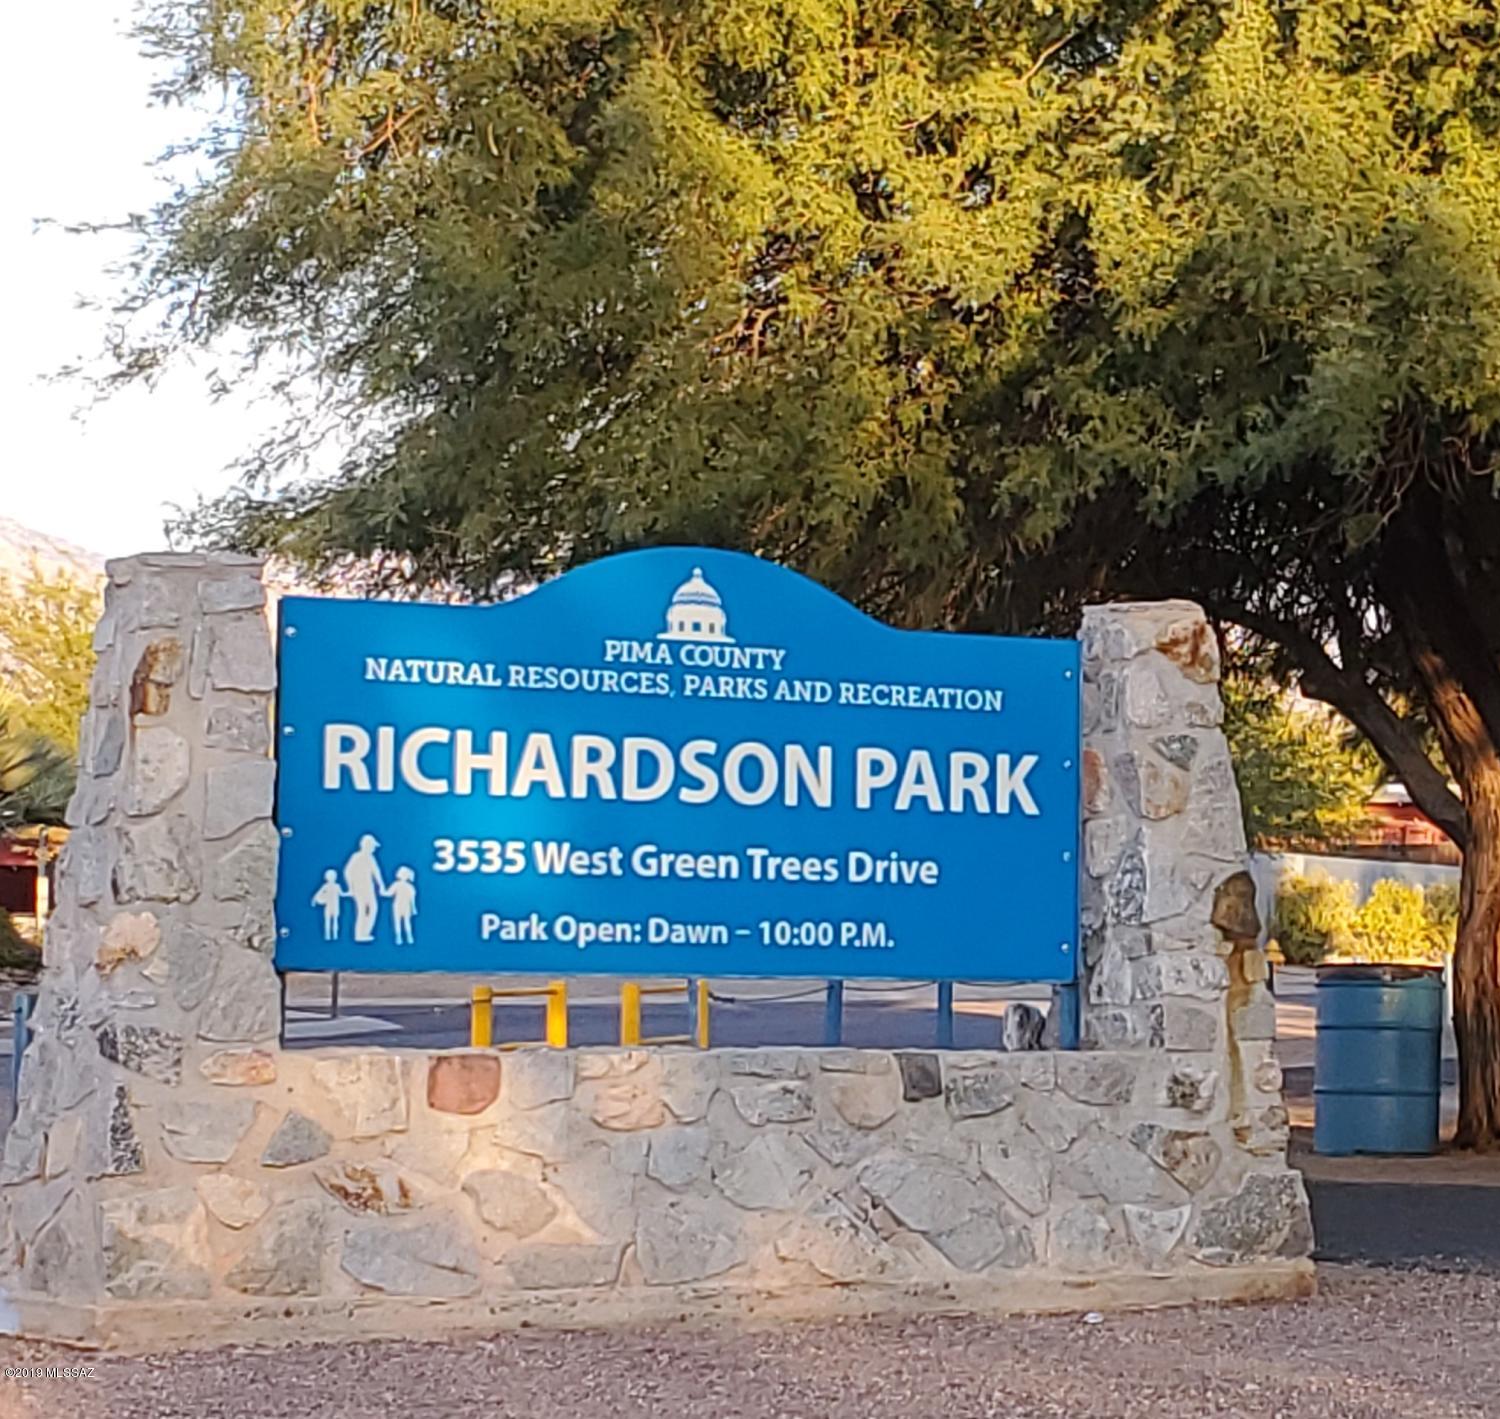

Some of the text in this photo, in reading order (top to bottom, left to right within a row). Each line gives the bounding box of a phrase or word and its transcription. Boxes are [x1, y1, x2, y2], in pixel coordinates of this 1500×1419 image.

[604, 639, 786, 671] PIMA COUNTY
[364, 657, 1003, 711] NATURAL RESOURCES, PARKS AND RECREATION
[323, 723, 1041, 816] RICHARDSON PARK
[432, 838, 939, 885] 3535 West Green Trees Drive
[481, 913, 549, 941] Park
[553, 914, 642, 949] Open:
[647, 917, 728, 945] Dawn
[758, 920, 834, 947] 10:00
[840, 921, 895, 948] P.M.
